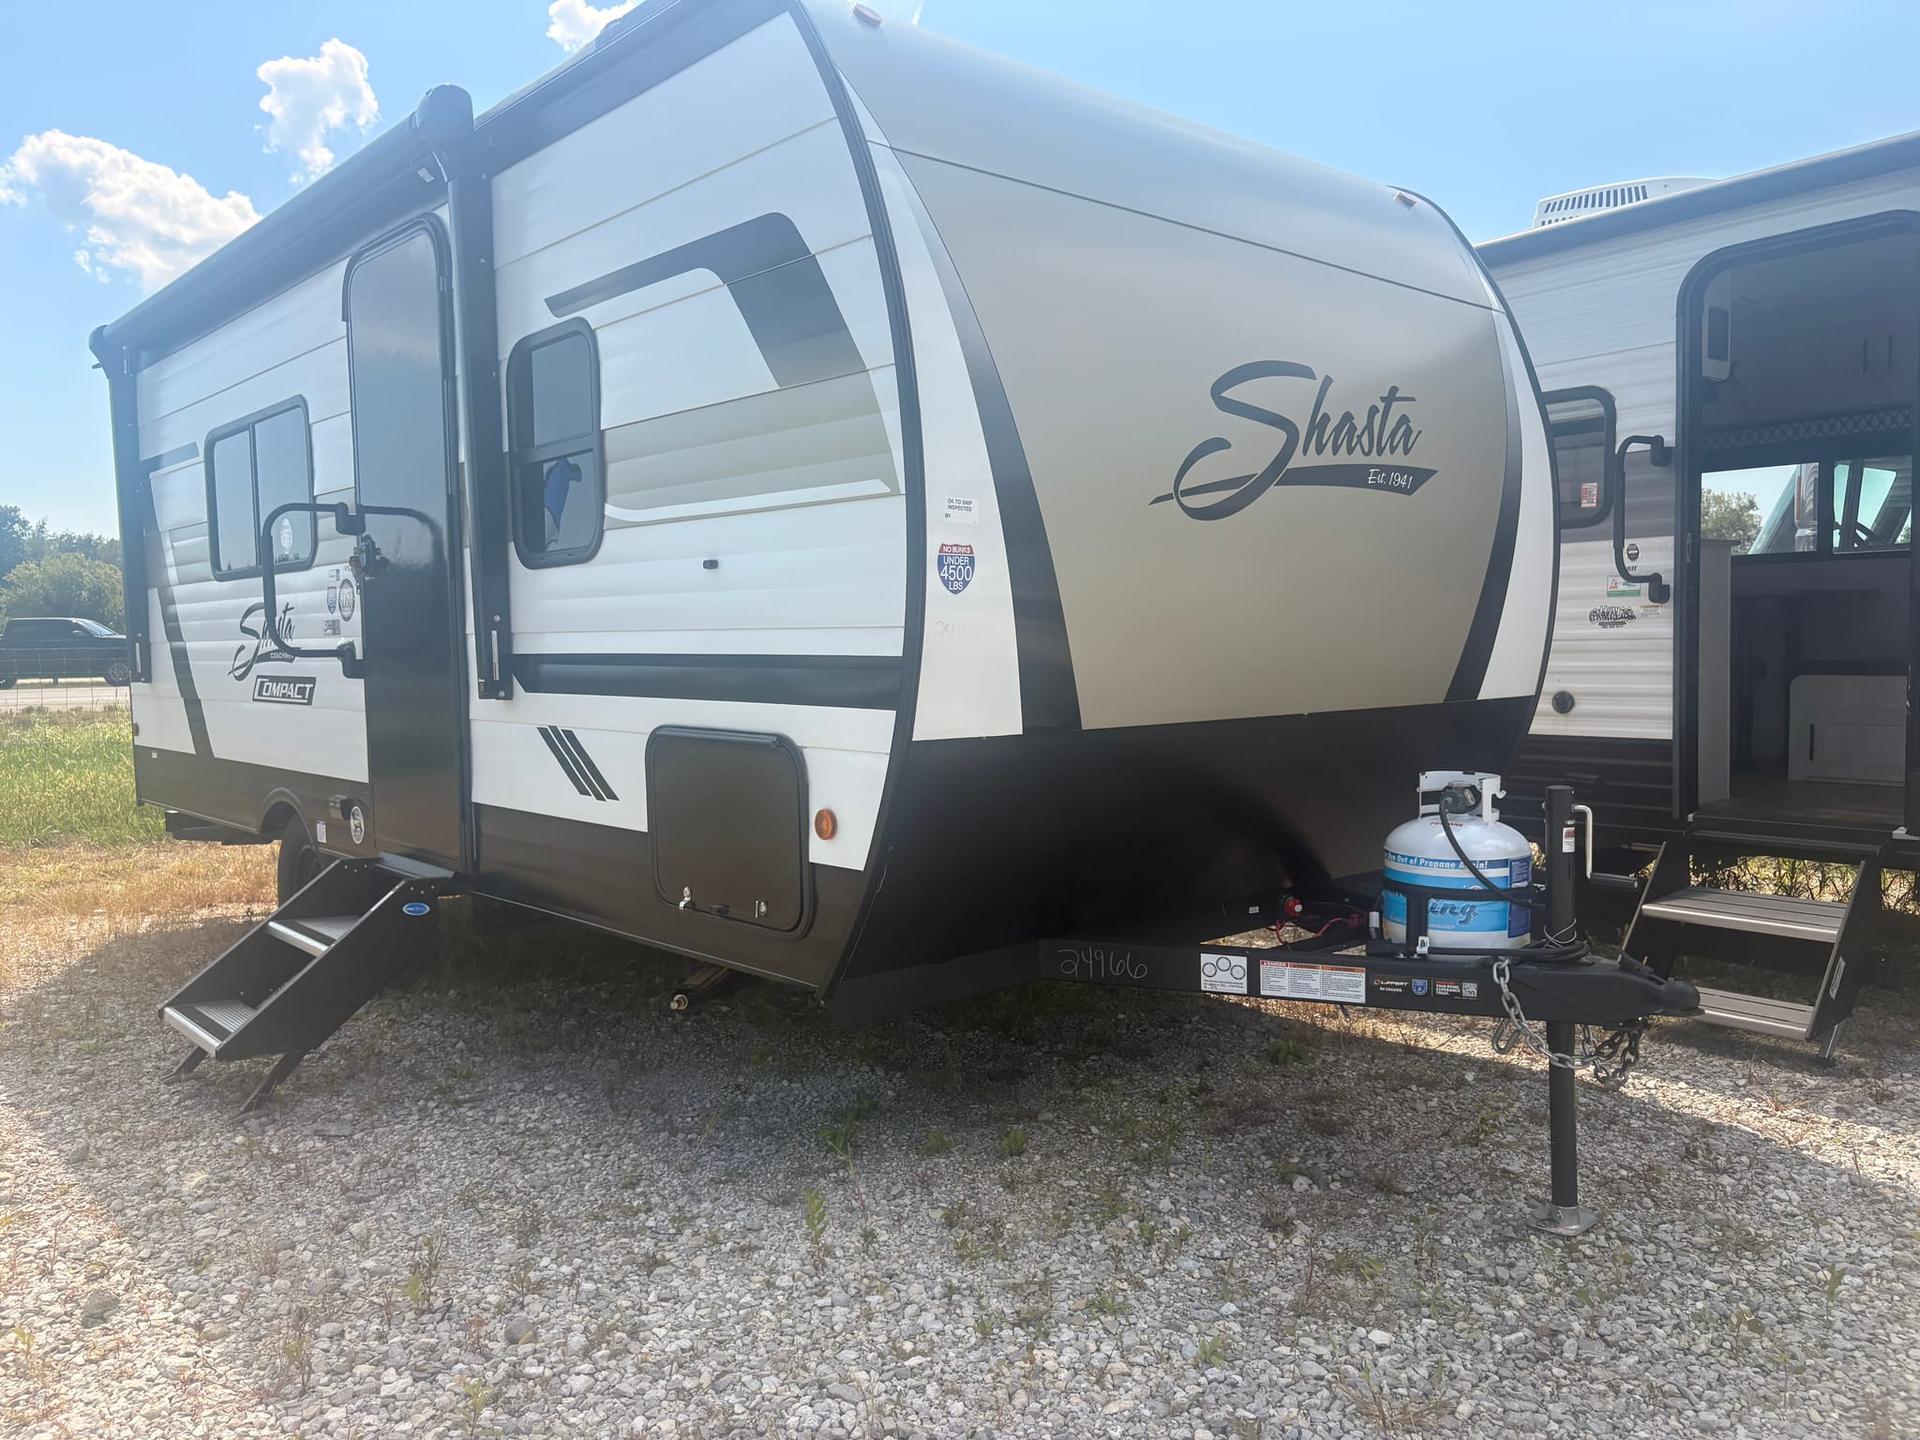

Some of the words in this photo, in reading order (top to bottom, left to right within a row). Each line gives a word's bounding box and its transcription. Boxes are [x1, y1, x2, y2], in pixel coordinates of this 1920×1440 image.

[1173, 360, 1422, 521] Shasta
[1368, 468, 1386, 484] Est.
[1389, 472, 1413, 489] 1941
[942, 545, 951, 553] NO
[943, 556, 969, 566] UNDER
[940, 565, 972, 581] 4500
[948, 581, 963, 591] LBS
[254, 678, 314, 702] COMPACT
[1396, 855, 1407, 864] Out
[1409, 857, 1417, 865] of
[1419, 858, 1456, 870] Propane
[1057, 946, 1148, 979] 24966
